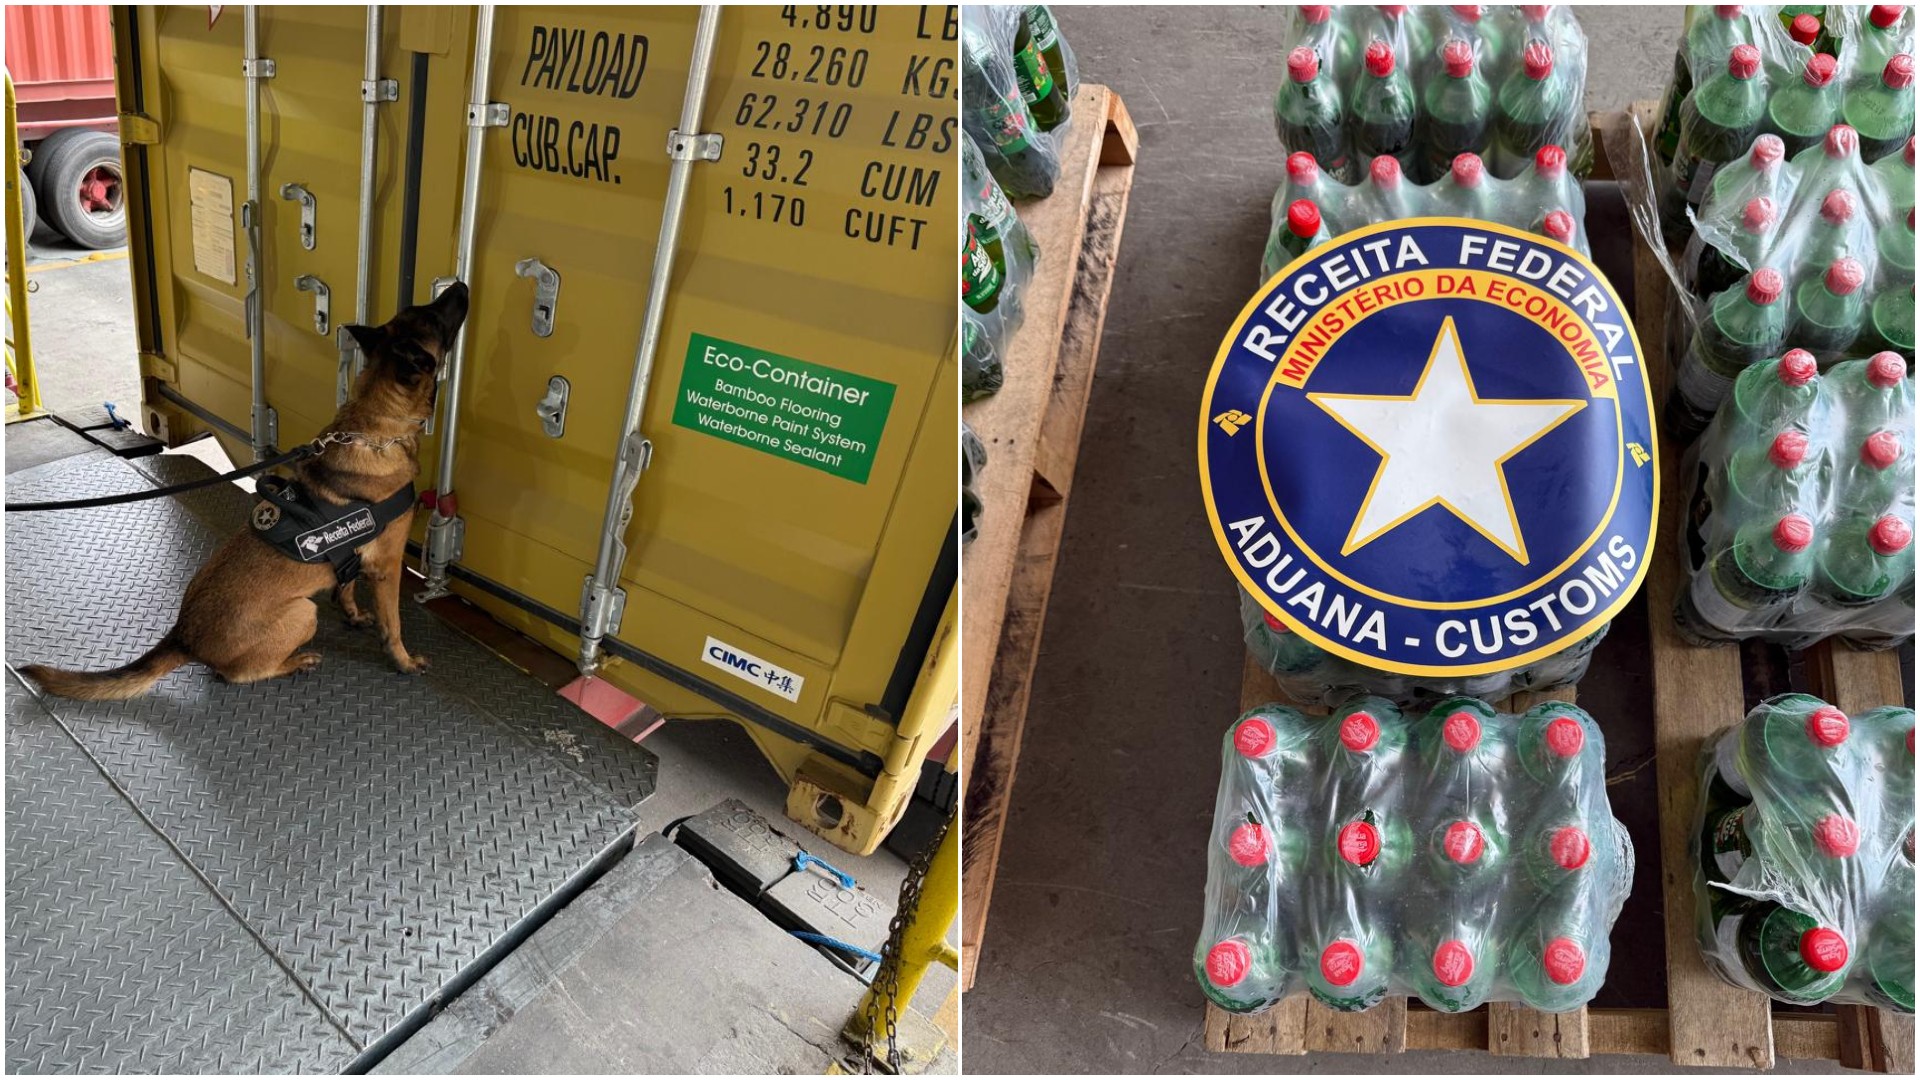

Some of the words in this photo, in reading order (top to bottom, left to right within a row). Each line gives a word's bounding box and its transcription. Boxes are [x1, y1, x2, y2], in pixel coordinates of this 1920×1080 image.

[781, 5, 877, 33] 4,890
[521, 26, 649, 98] PAYLOAD
[751, 40, 869, 88] 28,260
[901, 55, 958, 100] KG
[512, 113, 622, 185] CUB.CAP.
[735, 92, 853, 139] 62,310
[881, 110, 958, 154] LBS
[742, 142, 814, 187] 33.2
[860, 161, 941, 208] CUM
[723, 186, 805, 228] 1,170
[844, 208, 928, 251] CUFT
[1242, 234, 1429, 362] RECEITA
[1458, 234, 1636, 381] FEDERAL
[1281, 276, 1425, 382] MINISTÉRIO
[1435, 274, 1477, 296] DA
[1485, 275, 1610, 390] ECONOMIA
[703, 345, 869, 407] Eco-Container
[714, 379, 776, 407] Bamboo
[780, 397, 842, 428] Flooring
[687, 389, 769, 424] Waterborne
[771, 415, 809, 437] Paint
[811, 427, 866, 454] System
[698, 412, 780, 448] Waterborne
[783, 439, 842, 467] Sealant
[323, 526, 349, 544] Receita
[346, 513, 373, 535] Federal
[1228, 515, 1388, 651] ADUANA
[1404, 636, 1420, 648] -
[1435, 533, 1637, 658] CUSTOMS
[709, 646, 761, 677] CIMC
[764, 669, 794, 694] 中集
